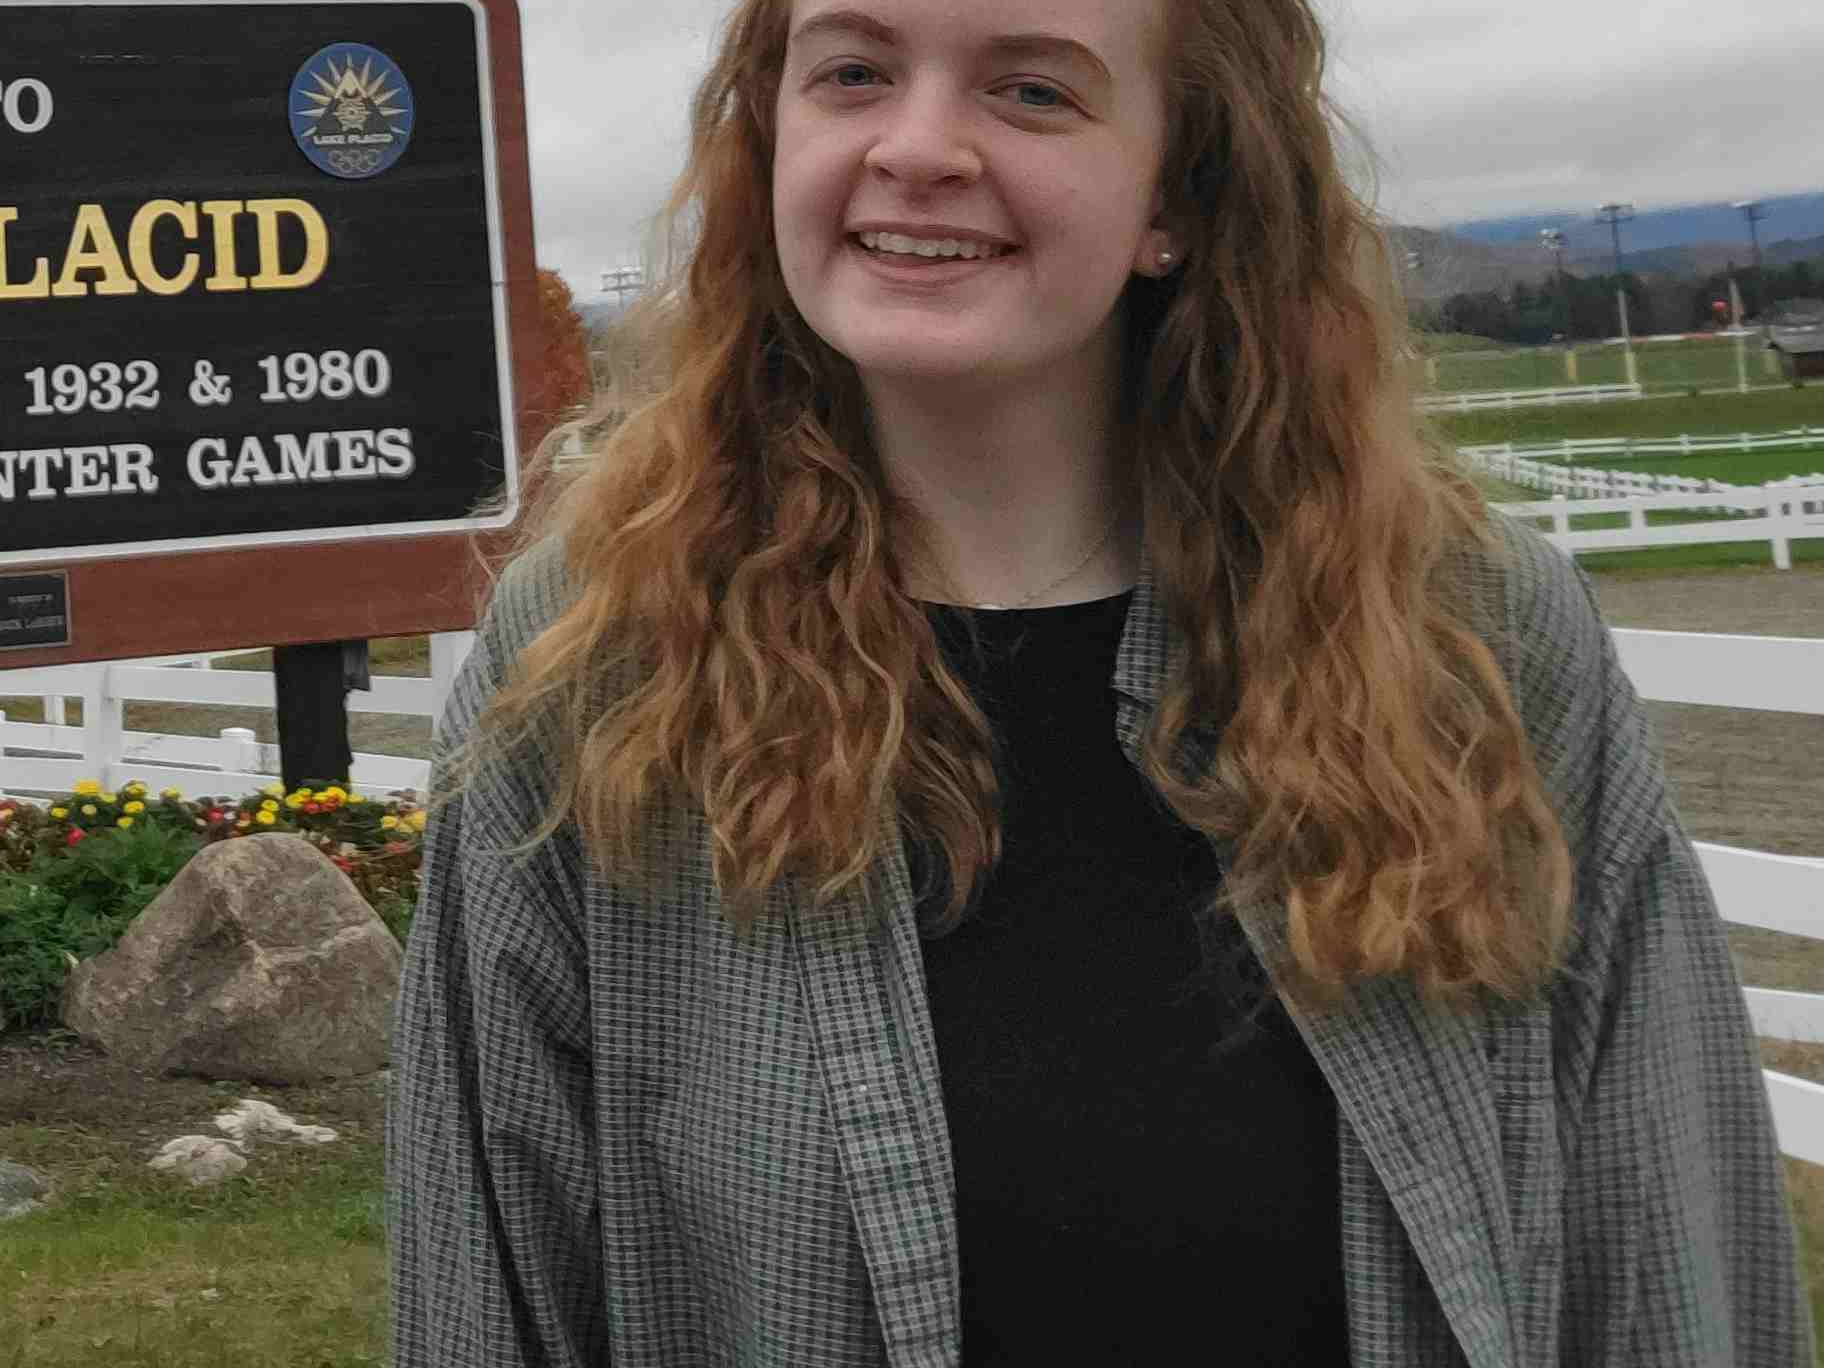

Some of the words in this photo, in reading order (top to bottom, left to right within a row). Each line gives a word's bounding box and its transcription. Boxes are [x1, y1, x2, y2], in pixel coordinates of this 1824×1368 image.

[24, 360, 160, 415] 1932
[188, 359, 232, 406] &
[257, 348, 391, 402] 1980
[186, 428, 415, 489] GAMES
